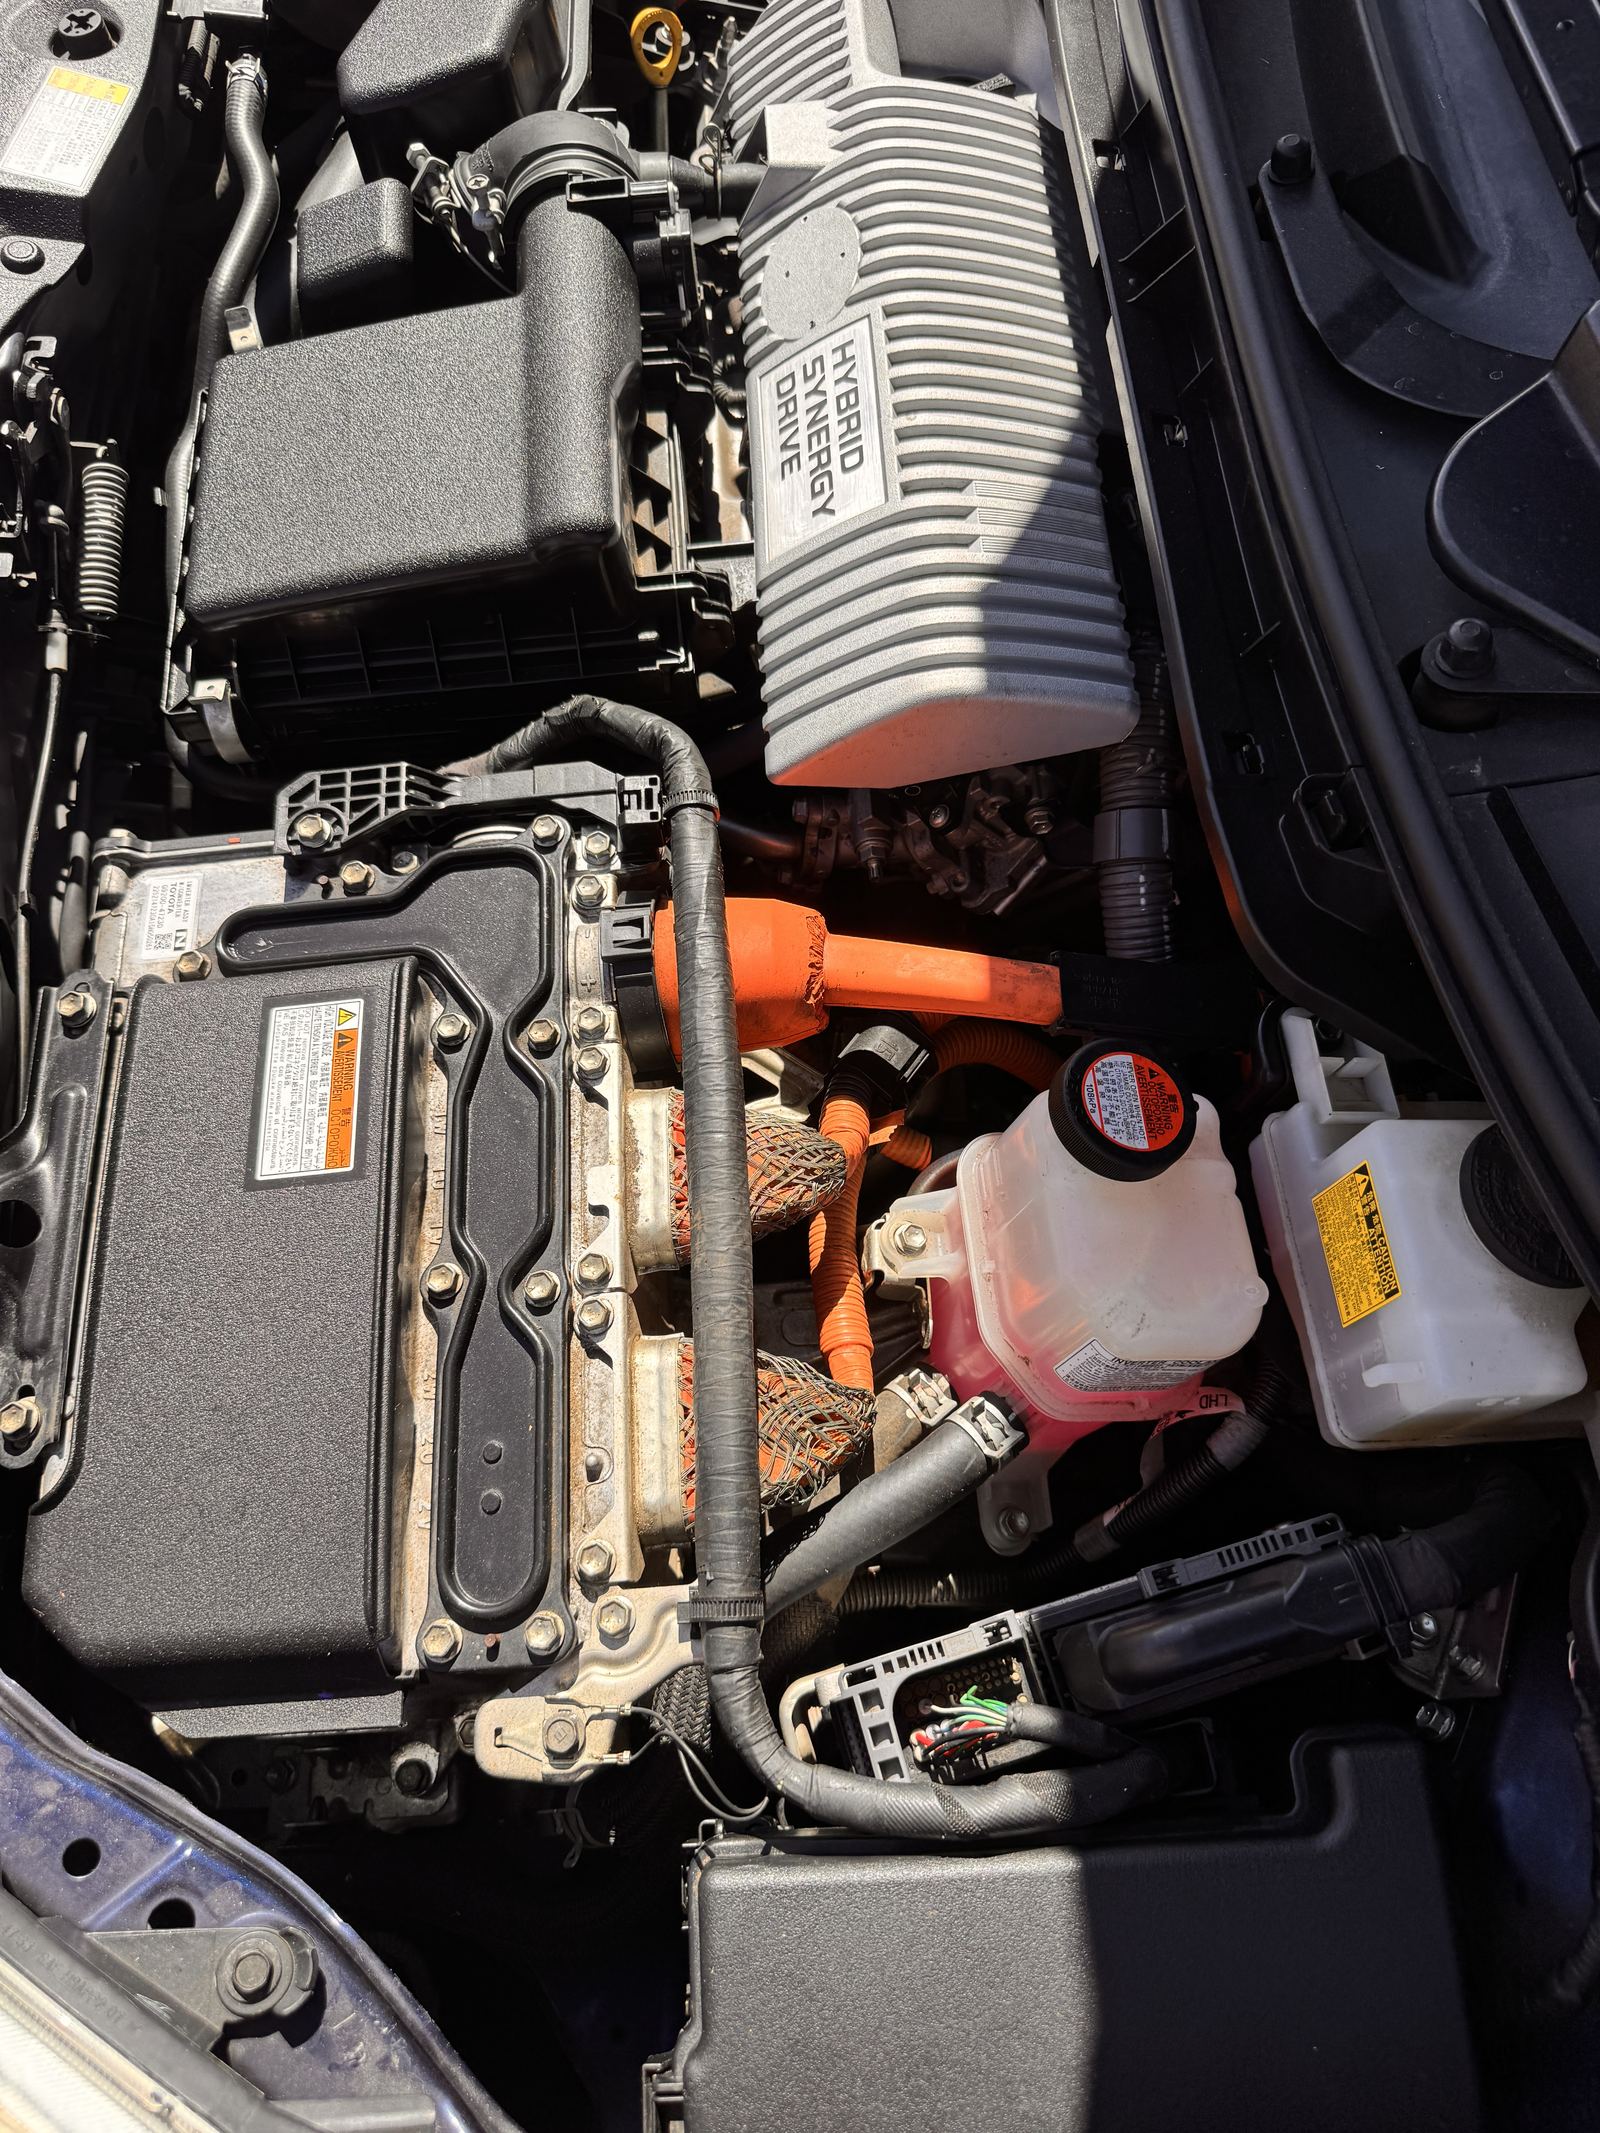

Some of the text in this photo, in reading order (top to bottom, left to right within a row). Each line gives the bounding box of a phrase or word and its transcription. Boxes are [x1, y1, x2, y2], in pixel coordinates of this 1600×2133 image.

[776, 371, 800, 480] DRIVE
[831, 338, 863, 472] HYBRID
[802, 354, 834, 516] SYNERGY
[168, 882, 177, 914] TOYOTA
[304, 1009, 310, 1018] DO
[332, 1050, 344, 1102] AVERTISSEMENT
[343, 1049, 354, 1092] WARNING
[1120, 1069, 1129, 1090] JAMAIS
[1085, 1084, 1096, 1113] 108kPa
[1124, 1091, 1133, 1113] OUVRIR
[1132, 1104, 1141, 1125] WHEN
[1135, 1065, 1156, 1139] AVERTISSEMENT
[1147, 1082, 1165, 1135] ОСТОРОЖНО
[1156, 1082, 1172, 1130] WARNING
[327, 1110, 340, 1167] ОСТОРОЖНО
[1368, 1228, 1390, 1291] ATTENTION
[1377, 1236, 1396, 1291] CAUTION
[1198, 1393, 1227, 1409] LHD
